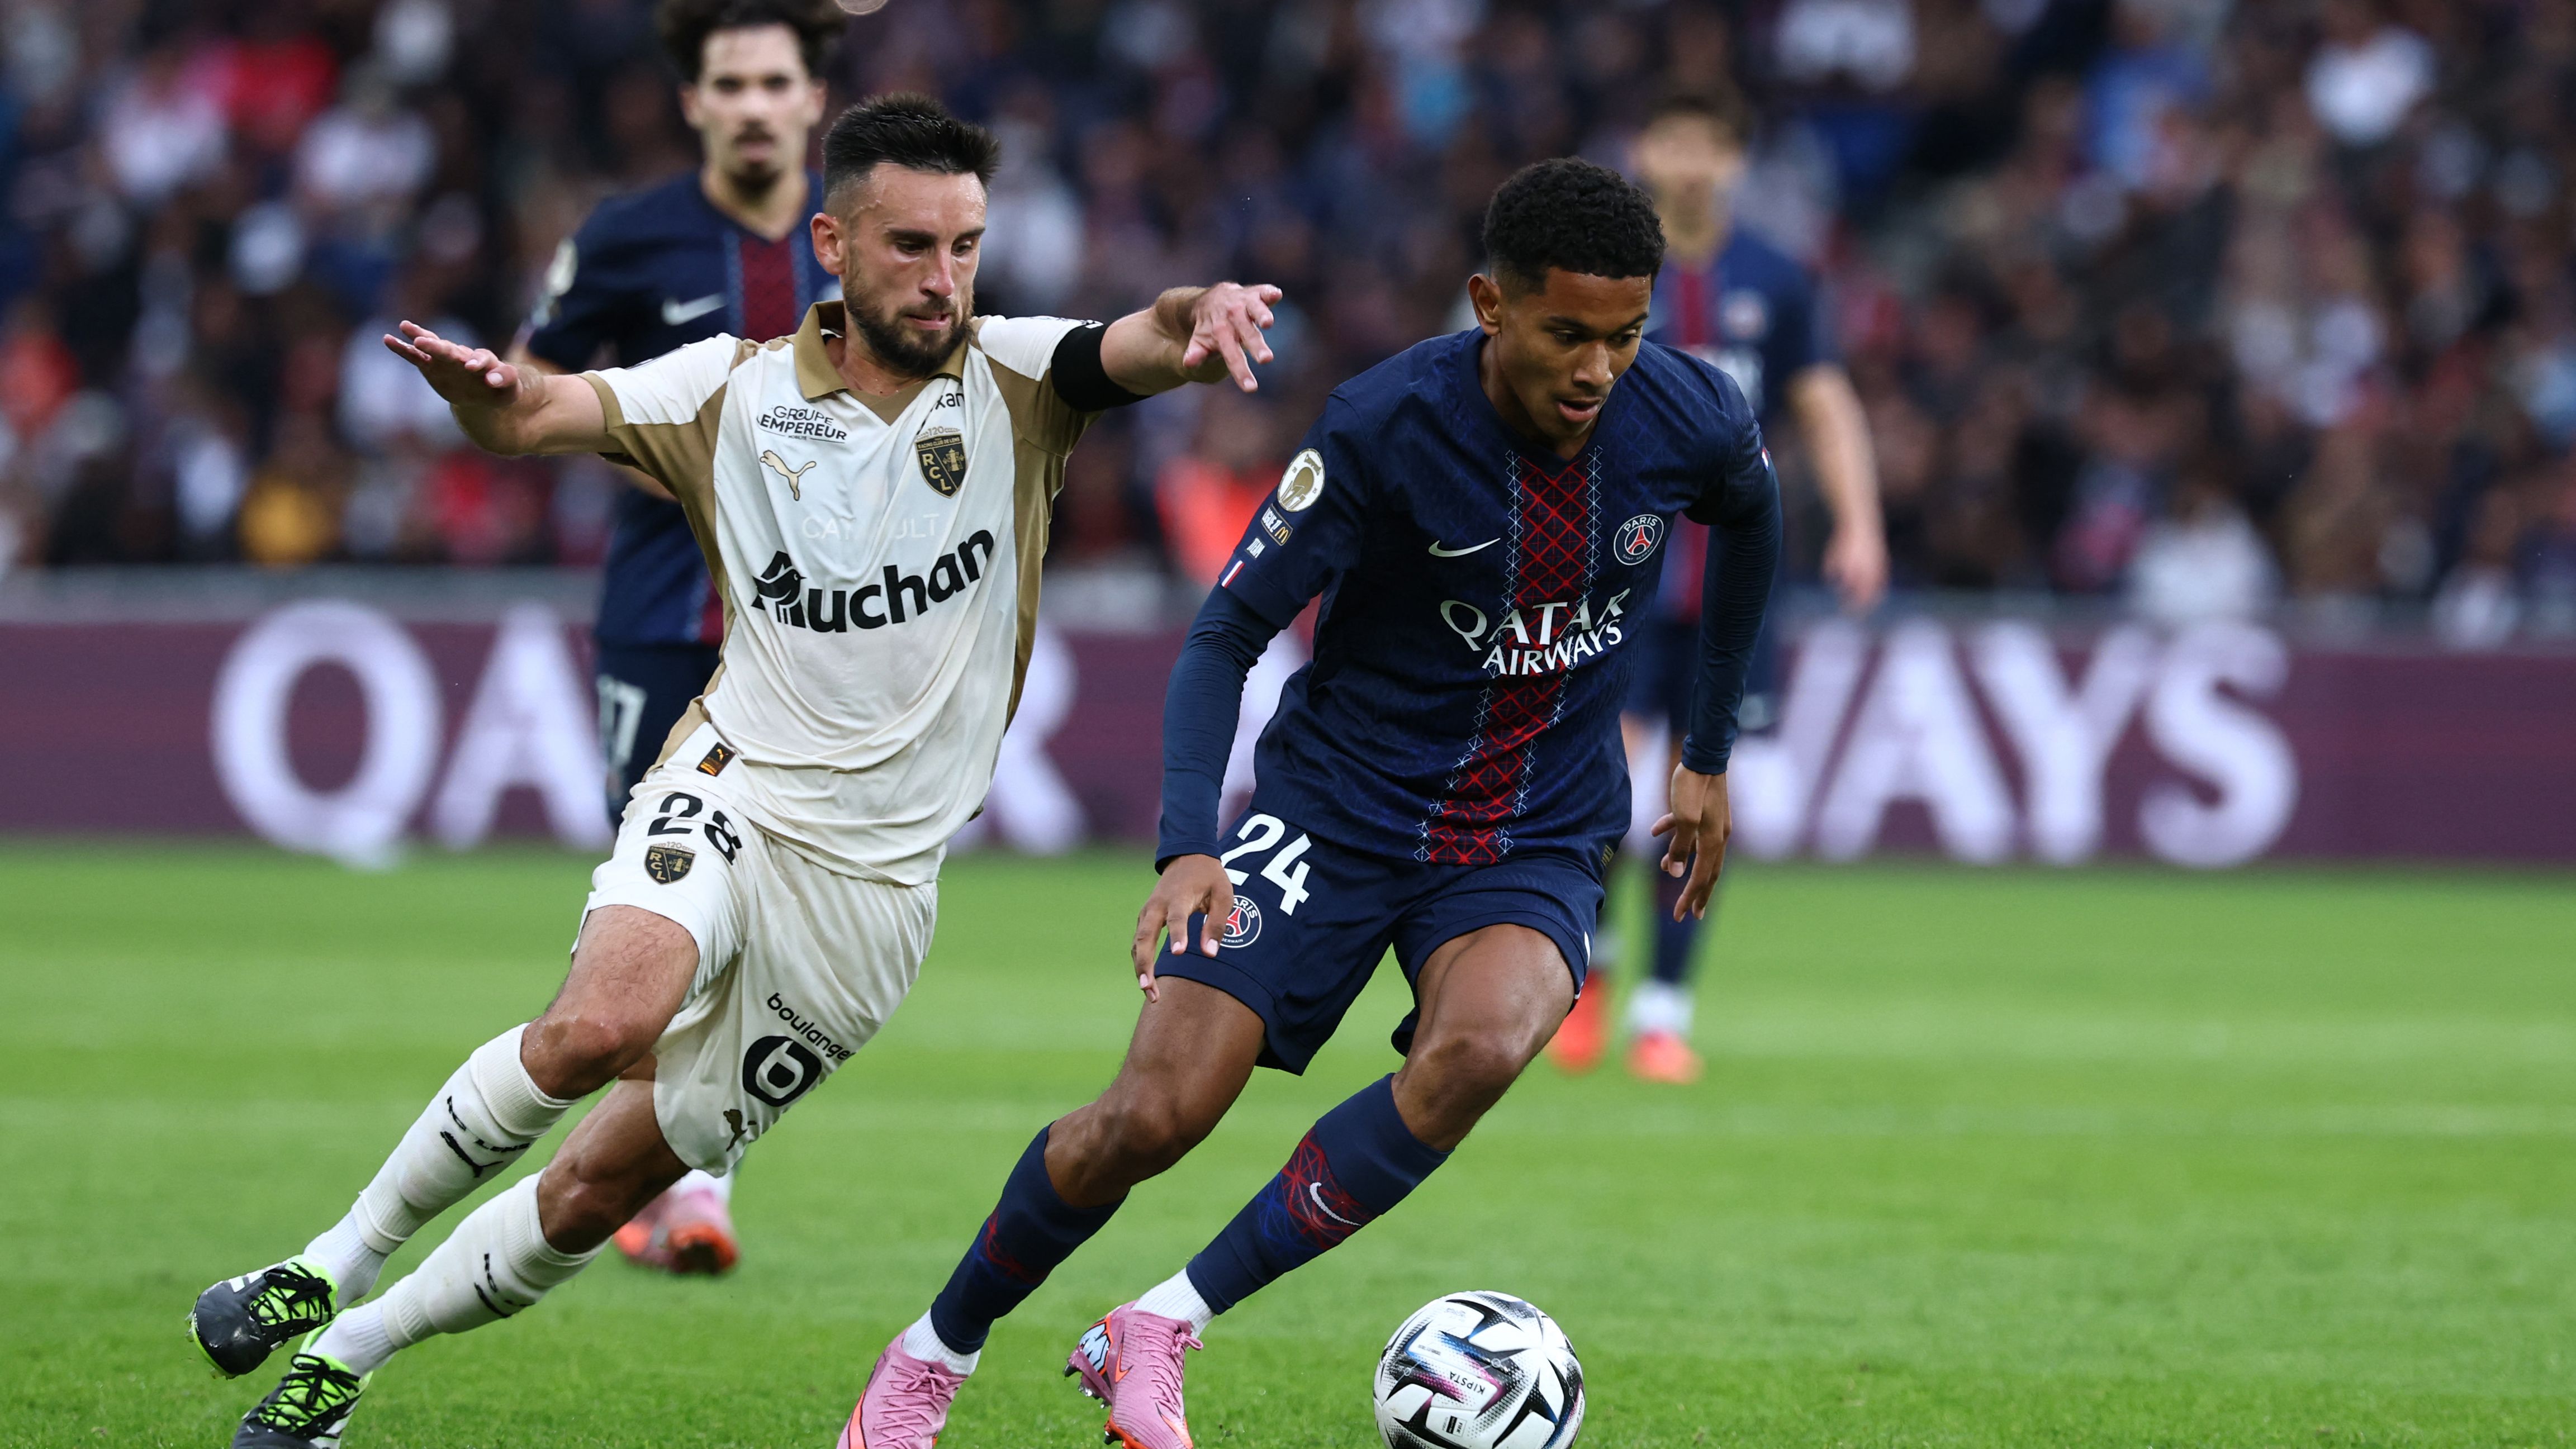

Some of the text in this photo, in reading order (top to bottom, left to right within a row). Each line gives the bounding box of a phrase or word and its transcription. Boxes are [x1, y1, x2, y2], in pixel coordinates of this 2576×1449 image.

[774, 406, 834, 426] GROUPE
[1624, 516, 1658, 532] PARIS
[751, 529, 994, 633] Auchan
[1440, 588, 1630, 652] QATAR
[1481, 619, 1623, 676] AIRWAYS
[648, 792, 742, 866] 28
[1220, 814, 1312, 916] 24
[1234, 897, 1258, 919] ARIS
[1450, 1371, 1486, 1395] KIPSTA
